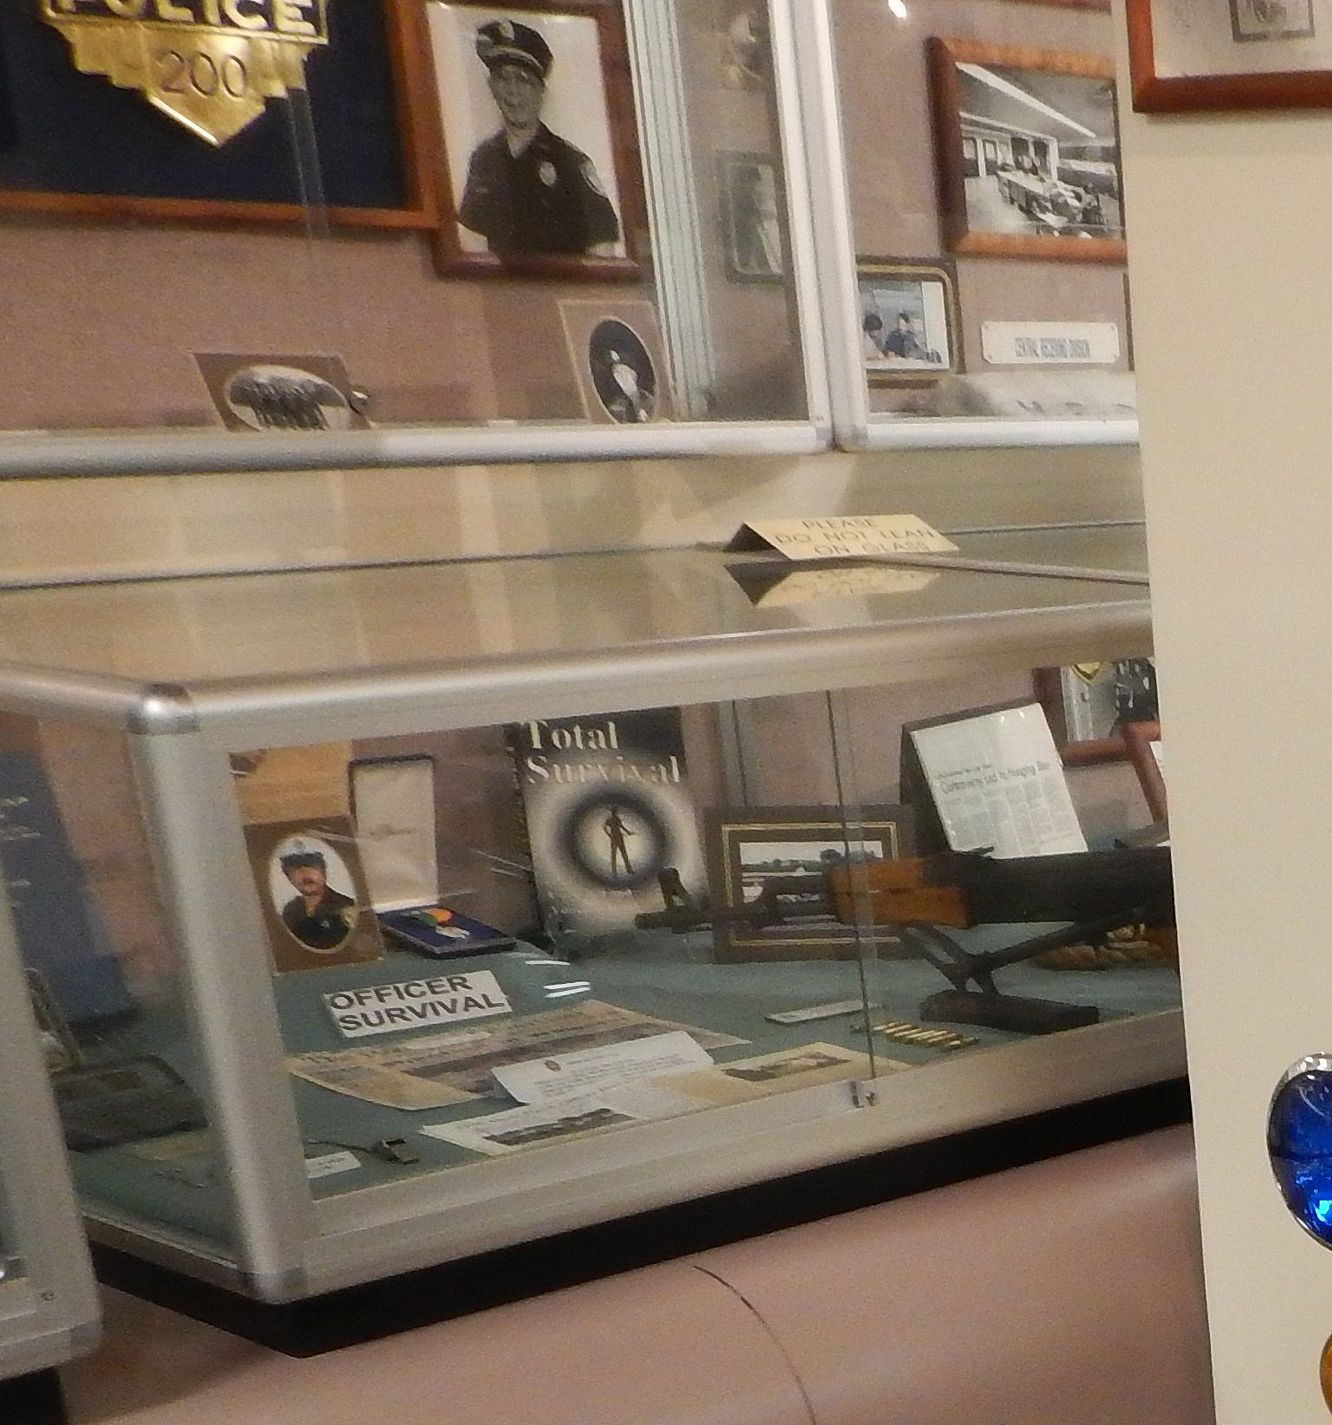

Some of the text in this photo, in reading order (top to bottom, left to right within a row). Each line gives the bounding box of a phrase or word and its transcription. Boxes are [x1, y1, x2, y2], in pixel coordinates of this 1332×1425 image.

[60, 0, 317, 35] LICE
[156, 50, 247, 98] 200
[775, 528, 935, 545] DO NOT LEAN
[801, 517, 875, 530] PLEASE
[814, 540, 930, 555] ON GLASS
[522, 719, 619, 750] Total
[527, 754, 681, 785] Survival
[329, 975, 473, 1010] OFFICER
[339, 993, 505, 1031] SURVIVAL
